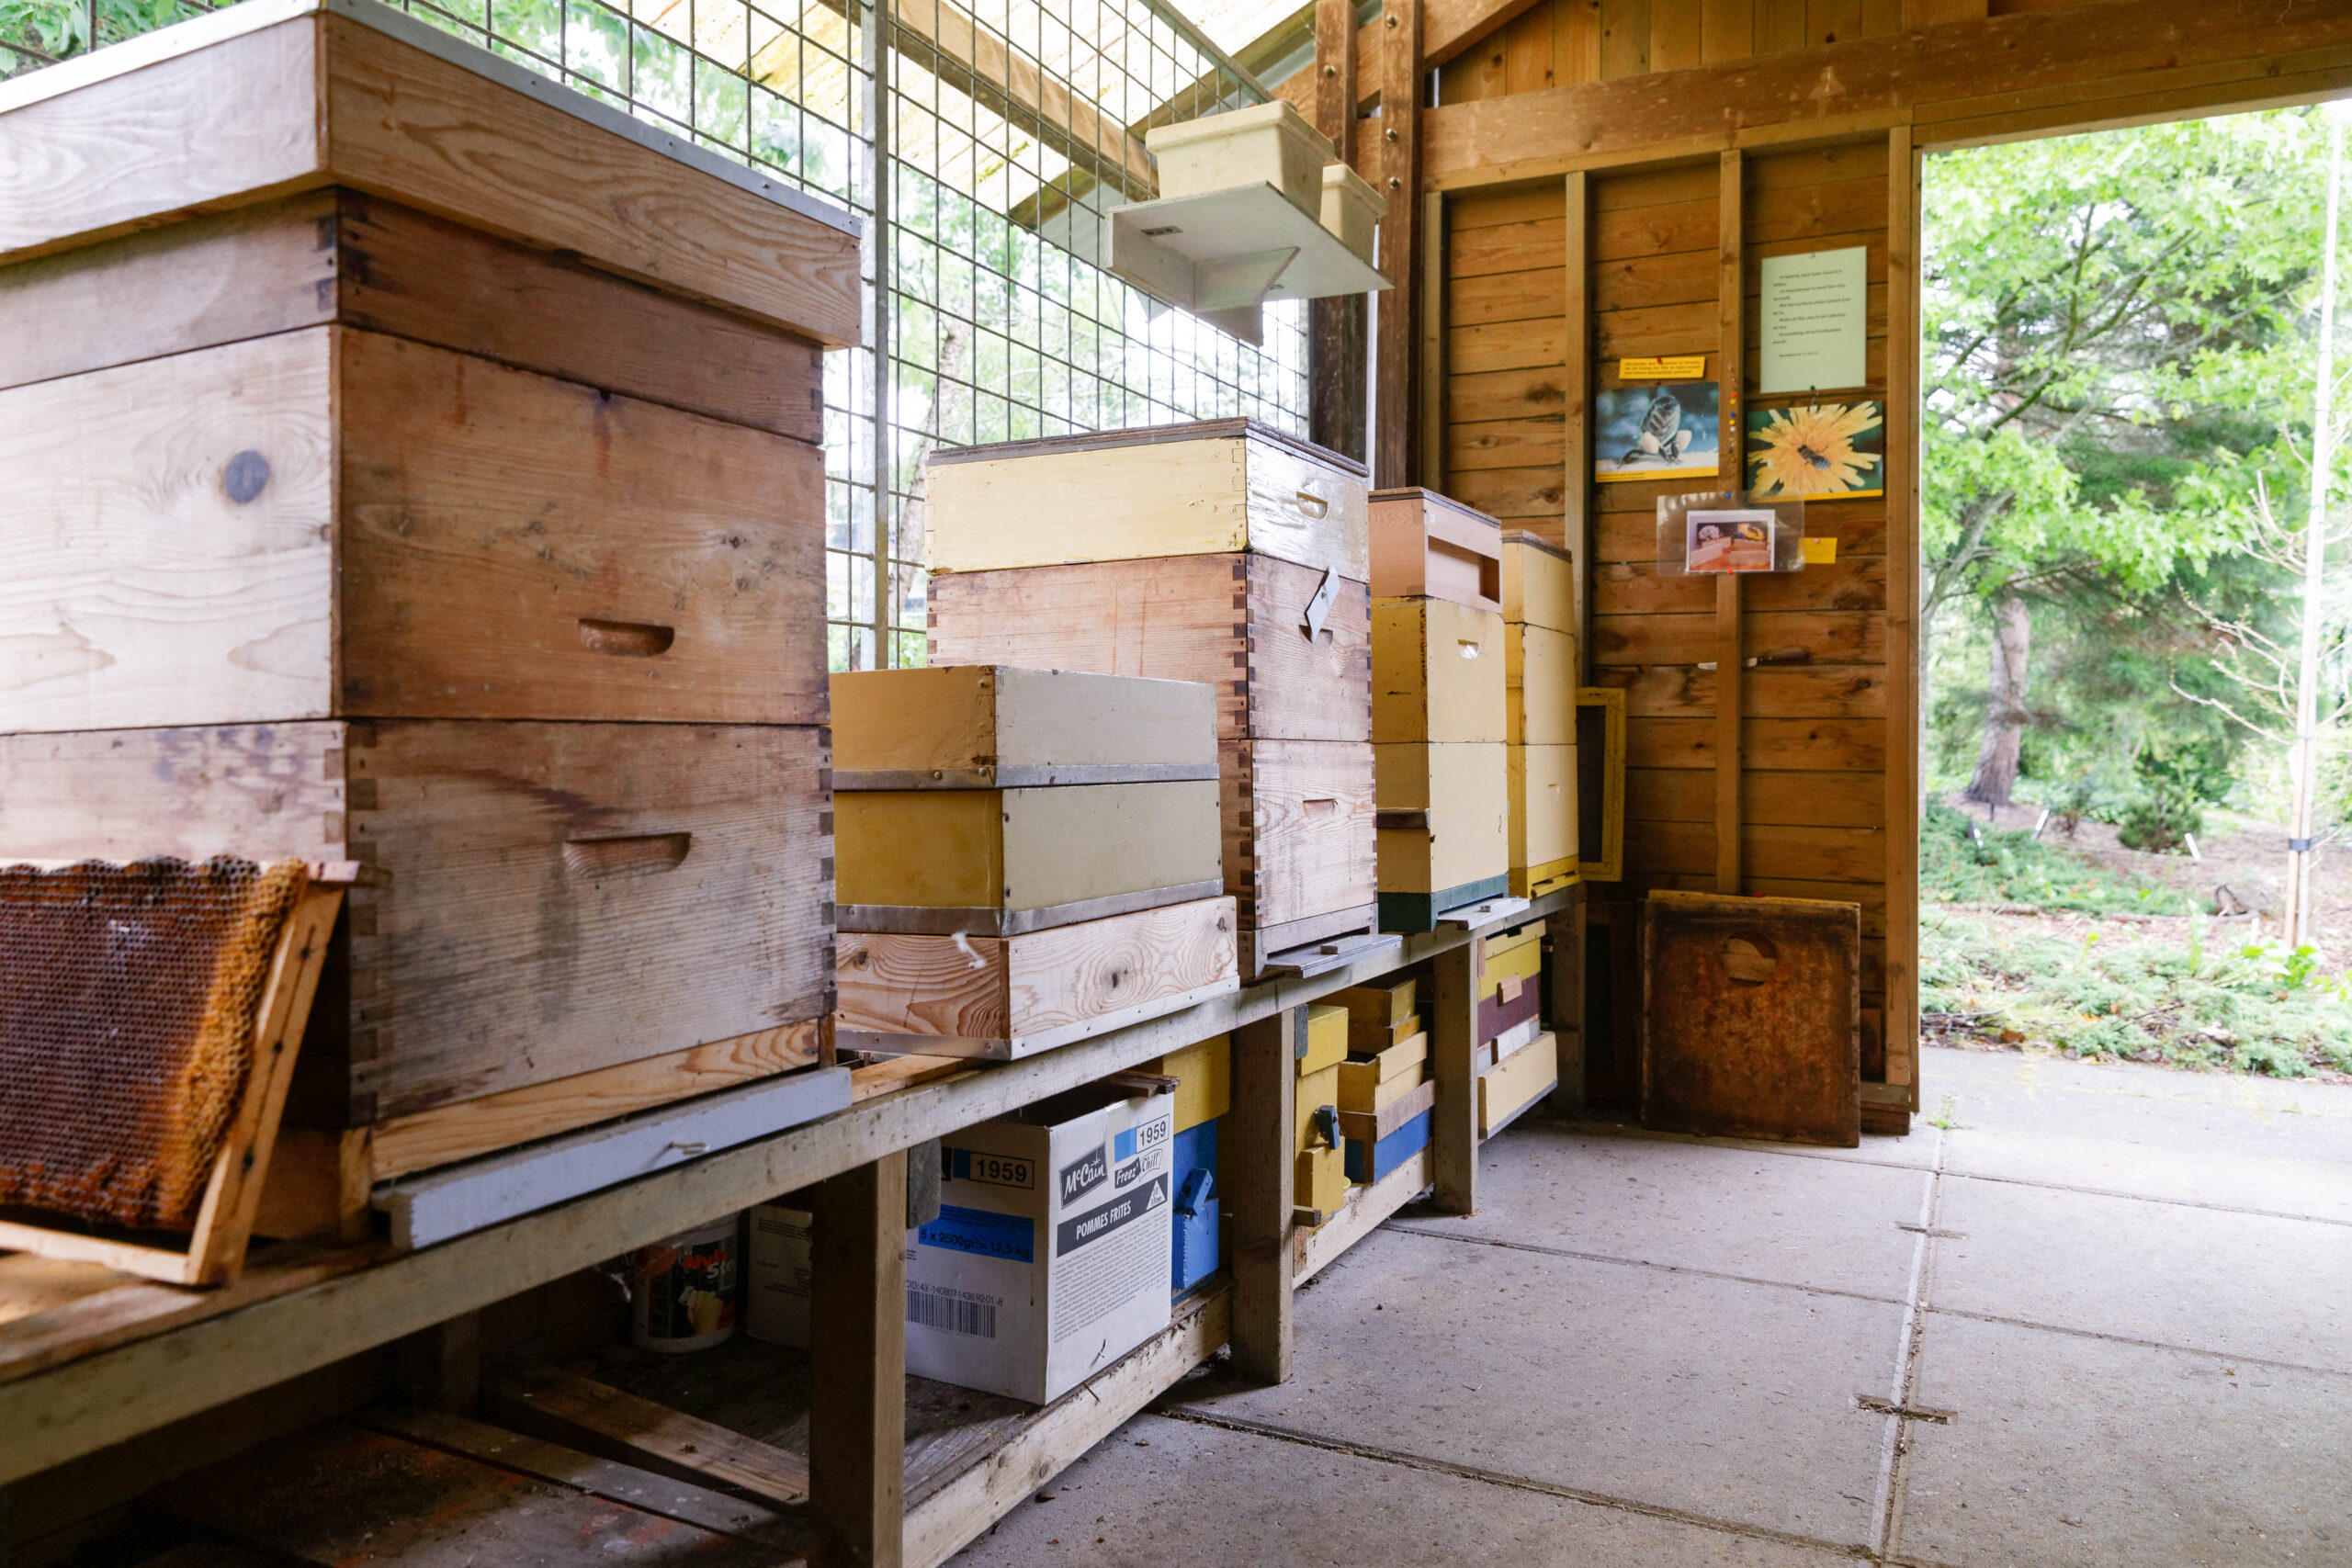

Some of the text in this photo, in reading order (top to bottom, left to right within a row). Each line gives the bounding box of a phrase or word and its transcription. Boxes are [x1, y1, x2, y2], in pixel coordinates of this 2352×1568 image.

[1140, 1121, 1167, 1147] 1959
[978, 1159, 1027, 1182] 1959
[1064, 1162, 1106, 1200] McCain
[1076, 1200, 1132, 1240] POMMES FRITES
[921, 1229, 927, 1239] 5
[990, 1242, 1012, 1257] 12,5
[1015, 1245, 1030, 1259] kg
